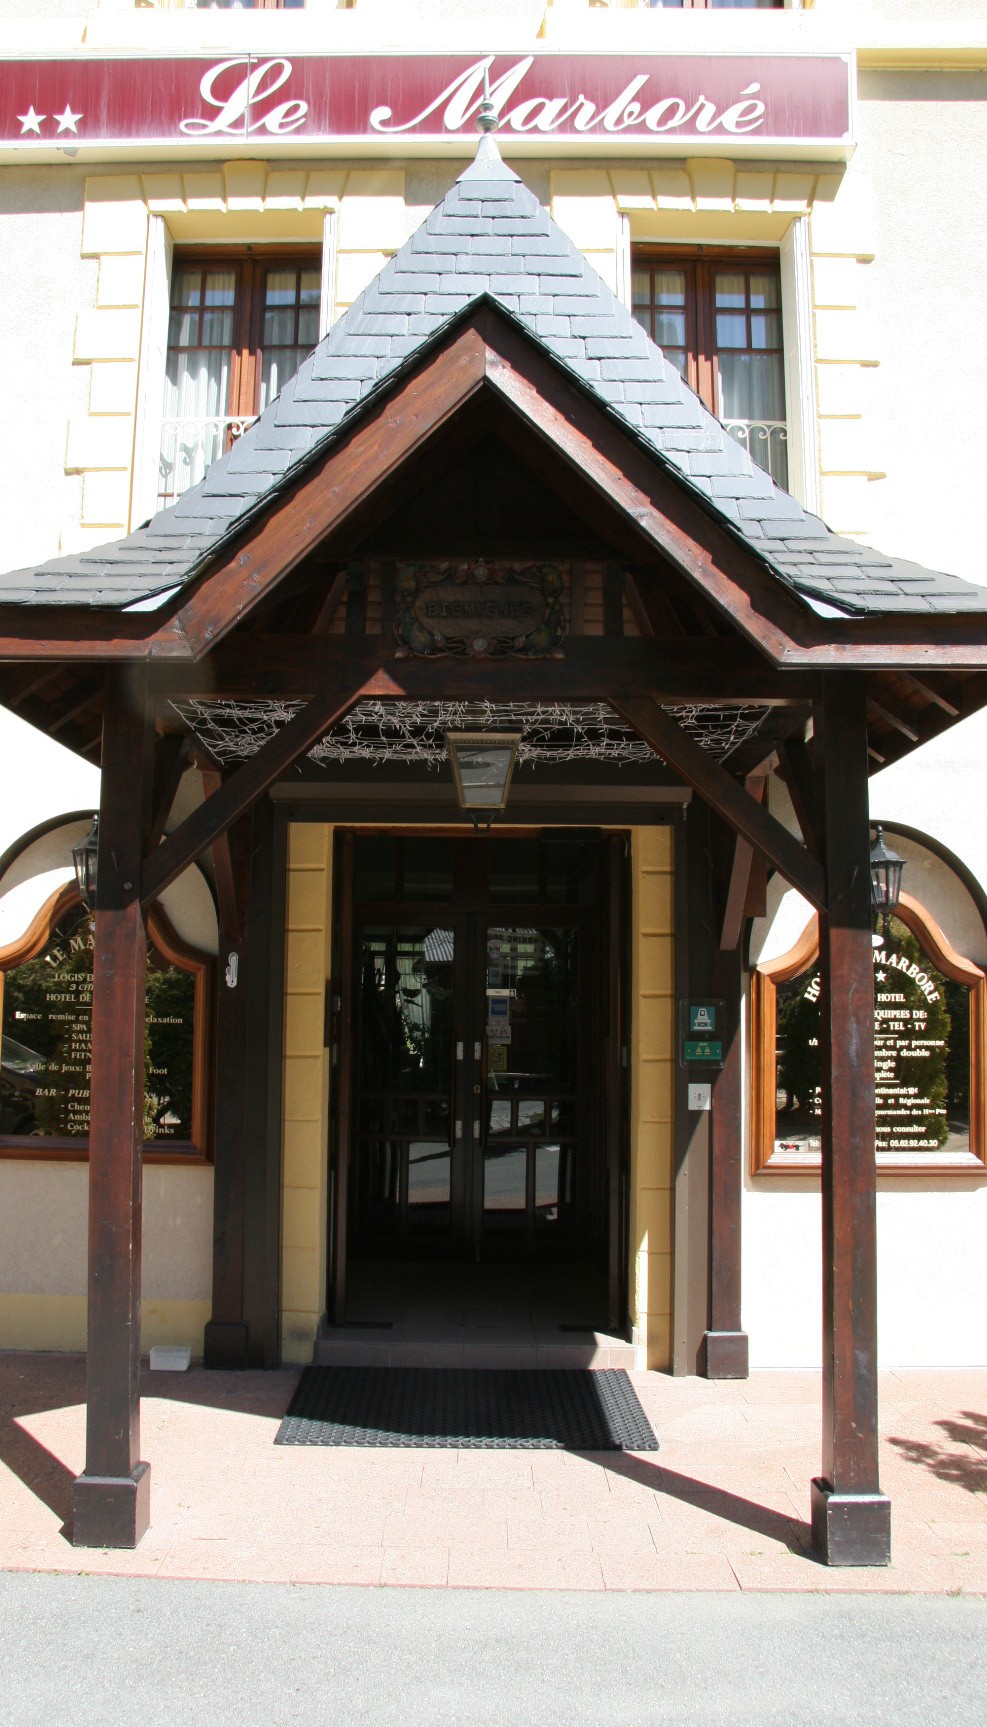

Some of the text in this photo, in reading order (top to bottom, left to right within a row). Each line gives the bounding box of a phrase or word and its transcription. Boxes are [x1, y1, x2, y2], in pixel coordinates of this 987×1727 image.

[179, 54, 766, 135] Le Marboré
[45, 947, 66, 967] LE
[69, 983, 76, 991] 3
[46, 993, 76, 1002] HOTEL
[878, 993, 905, 1002] HOTEL
[15, 1010, 42, 1021] Espace
[48, 1012, 76, 1020] remise
[72, 1023, 87, 1031] SPA
[889, 1021, 905, 1030] TEL
[914, 1021, 926, 1030] TV
[896, 1039, 909, 1048] par
[912, 1039, 945, 1048] personne
[900, 1048, 930, 1057] double
[61, 1064, 83, 1072] Jeux:
[149, 1066, 168, 1075] Foot
[35, 1088, 90, 1097] BAR PUB
[899, 1097, 930, 1106] Régionale
[893, 1124, 926, 1132] consulter
[889, 1139, 938, 1147] 05.62.92.40.30
